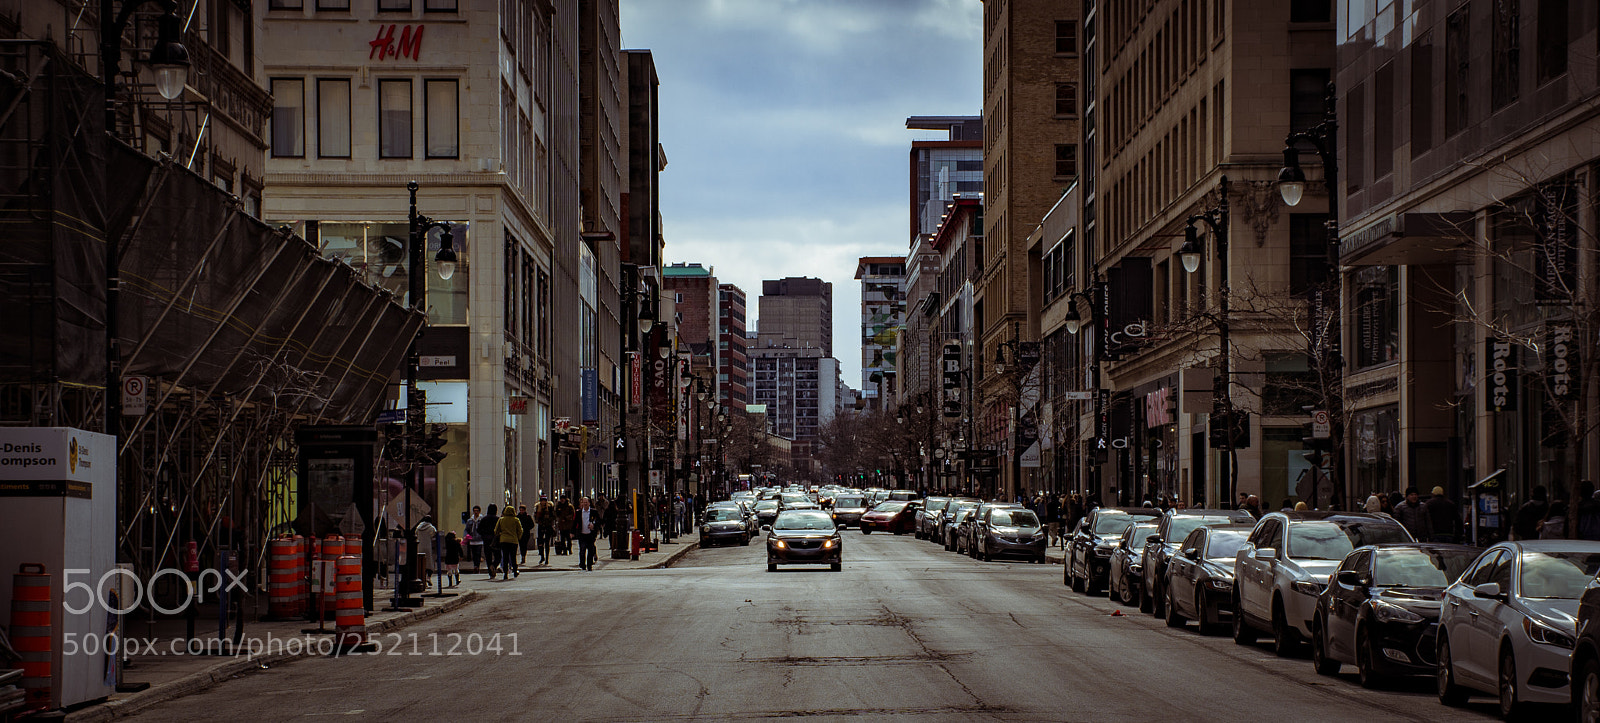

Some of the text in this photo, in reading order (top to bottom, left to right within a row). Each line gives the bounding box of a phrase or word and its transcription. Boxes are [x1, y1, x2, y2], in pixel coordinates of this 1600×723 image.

[369, 24, 425, 61] H&M
[1554, 326, 1573, 396] Roots
[510, 400, 526, 411] H&M
